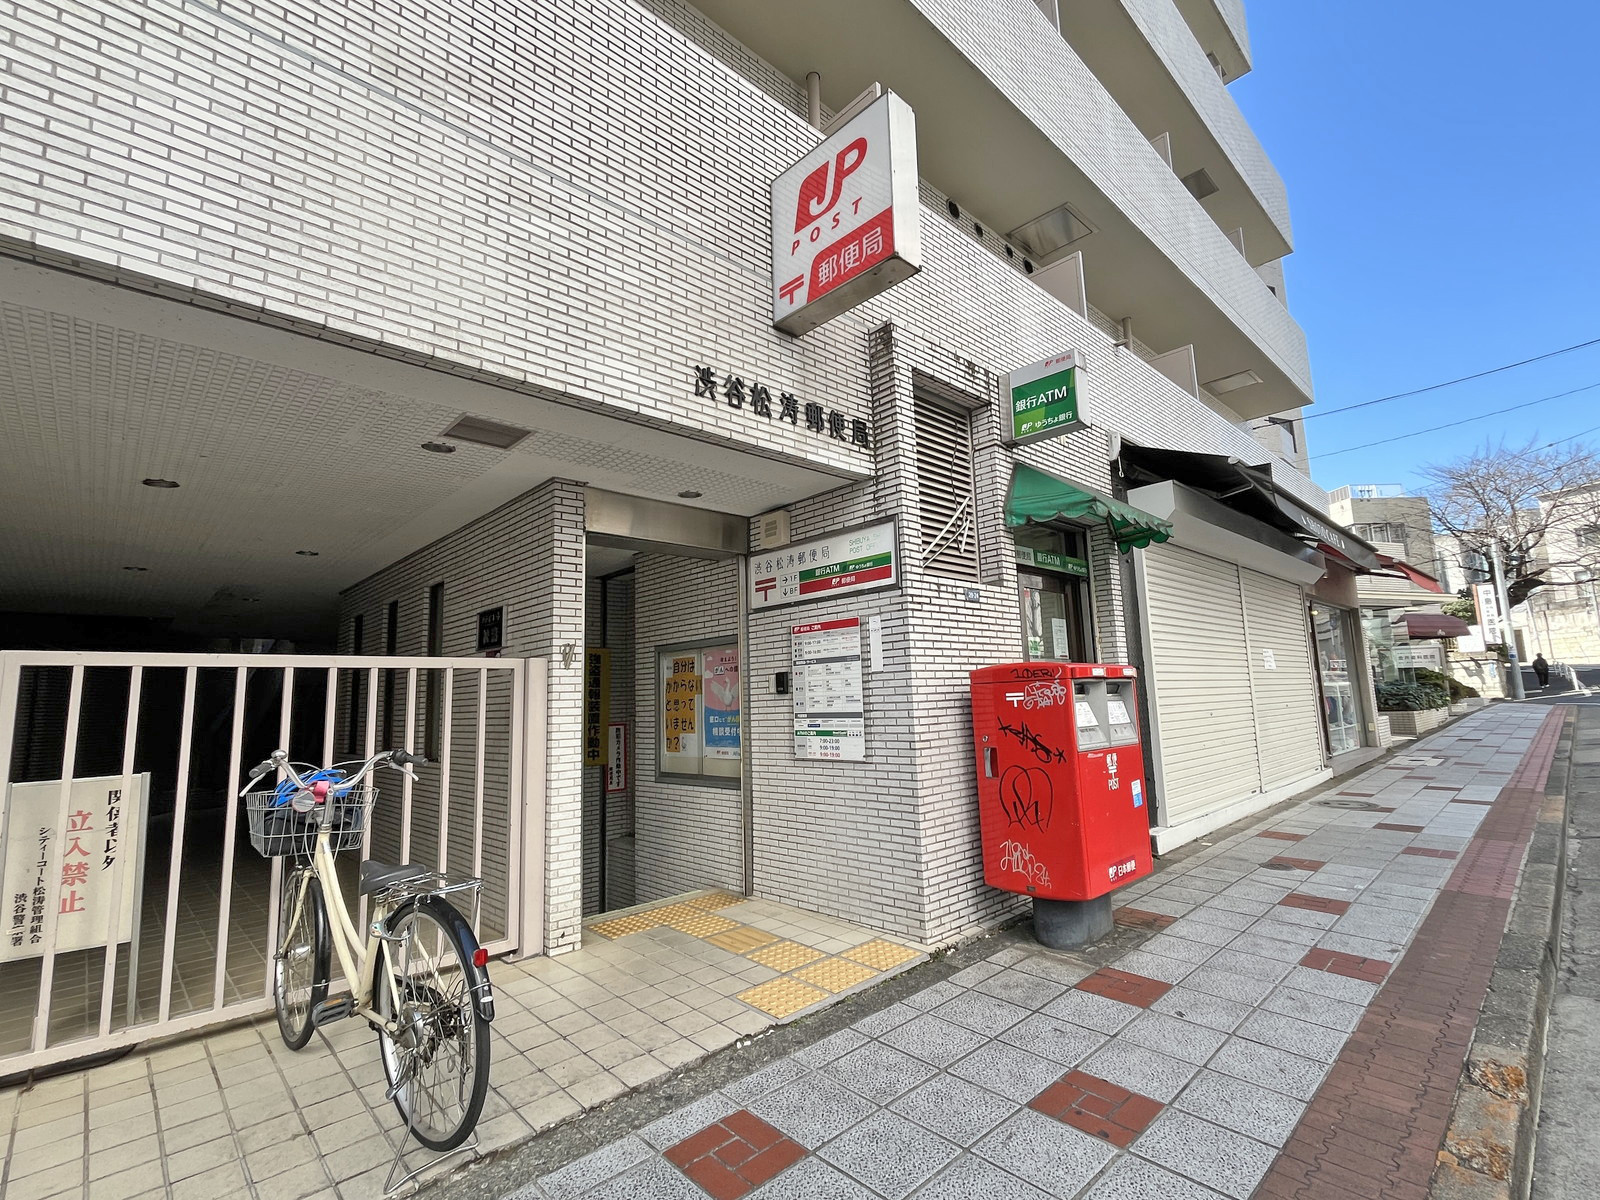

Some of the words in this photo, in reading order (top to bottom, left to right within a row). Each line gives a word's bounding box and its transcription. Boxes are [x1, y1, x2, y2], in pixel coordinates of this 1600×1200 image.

[794, 137, 868, 235] JP
[791, 197, 863, 256] POST
[817, 226, 884, 288] 郵便局
[1015, 386, 1067, 412] 銀行ATM
[1035, 411, 1072, 428] ゆうちょ銀行
[1037, 552, 1061, 566] 銀行ATM
[789, 574, 798, 582] 1F
[815, 563, 840, 577] 銀行ATM
[673, 661, 695, 674] 自分は
[665, 698, 694, 712] と思って
[1108, 778, 1120, 791] POST
[58, 810, 93, 915] 立入禁止
[1117, 859, 1136, 877] 日本郵便
